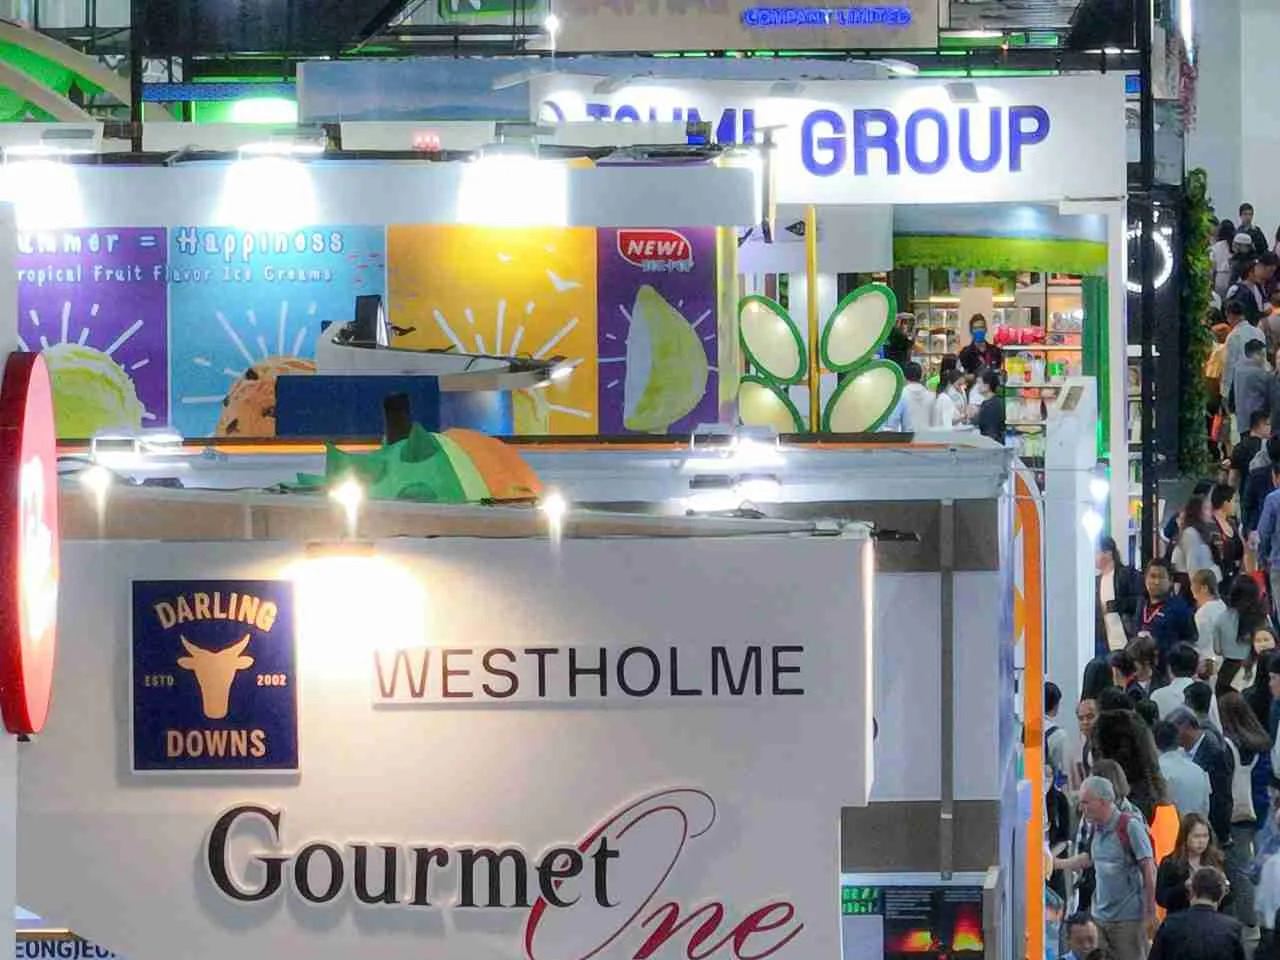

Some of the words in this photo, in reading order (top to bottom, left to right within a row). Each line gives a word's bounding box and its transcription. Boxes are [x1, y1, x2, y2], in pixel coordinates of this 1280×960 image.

[837, 9, 911, 26] LIMITED
[801, 105, 1051, 176] GROUP
[177, 227, 345, 262] Happiness
[627, 239, 685, 256] NEW!
[17, 266, 82, 287] ropical
[94, 266, 141, 282] Fruit
[154, 592, 278, 632] DARLING
[256, 674, 287, 686] 2002
[373, 646, 805, 699] WESTHOLME
[167, 729, 266, 757] DOWNS
[207, 805, 620, 908] Gourmet
